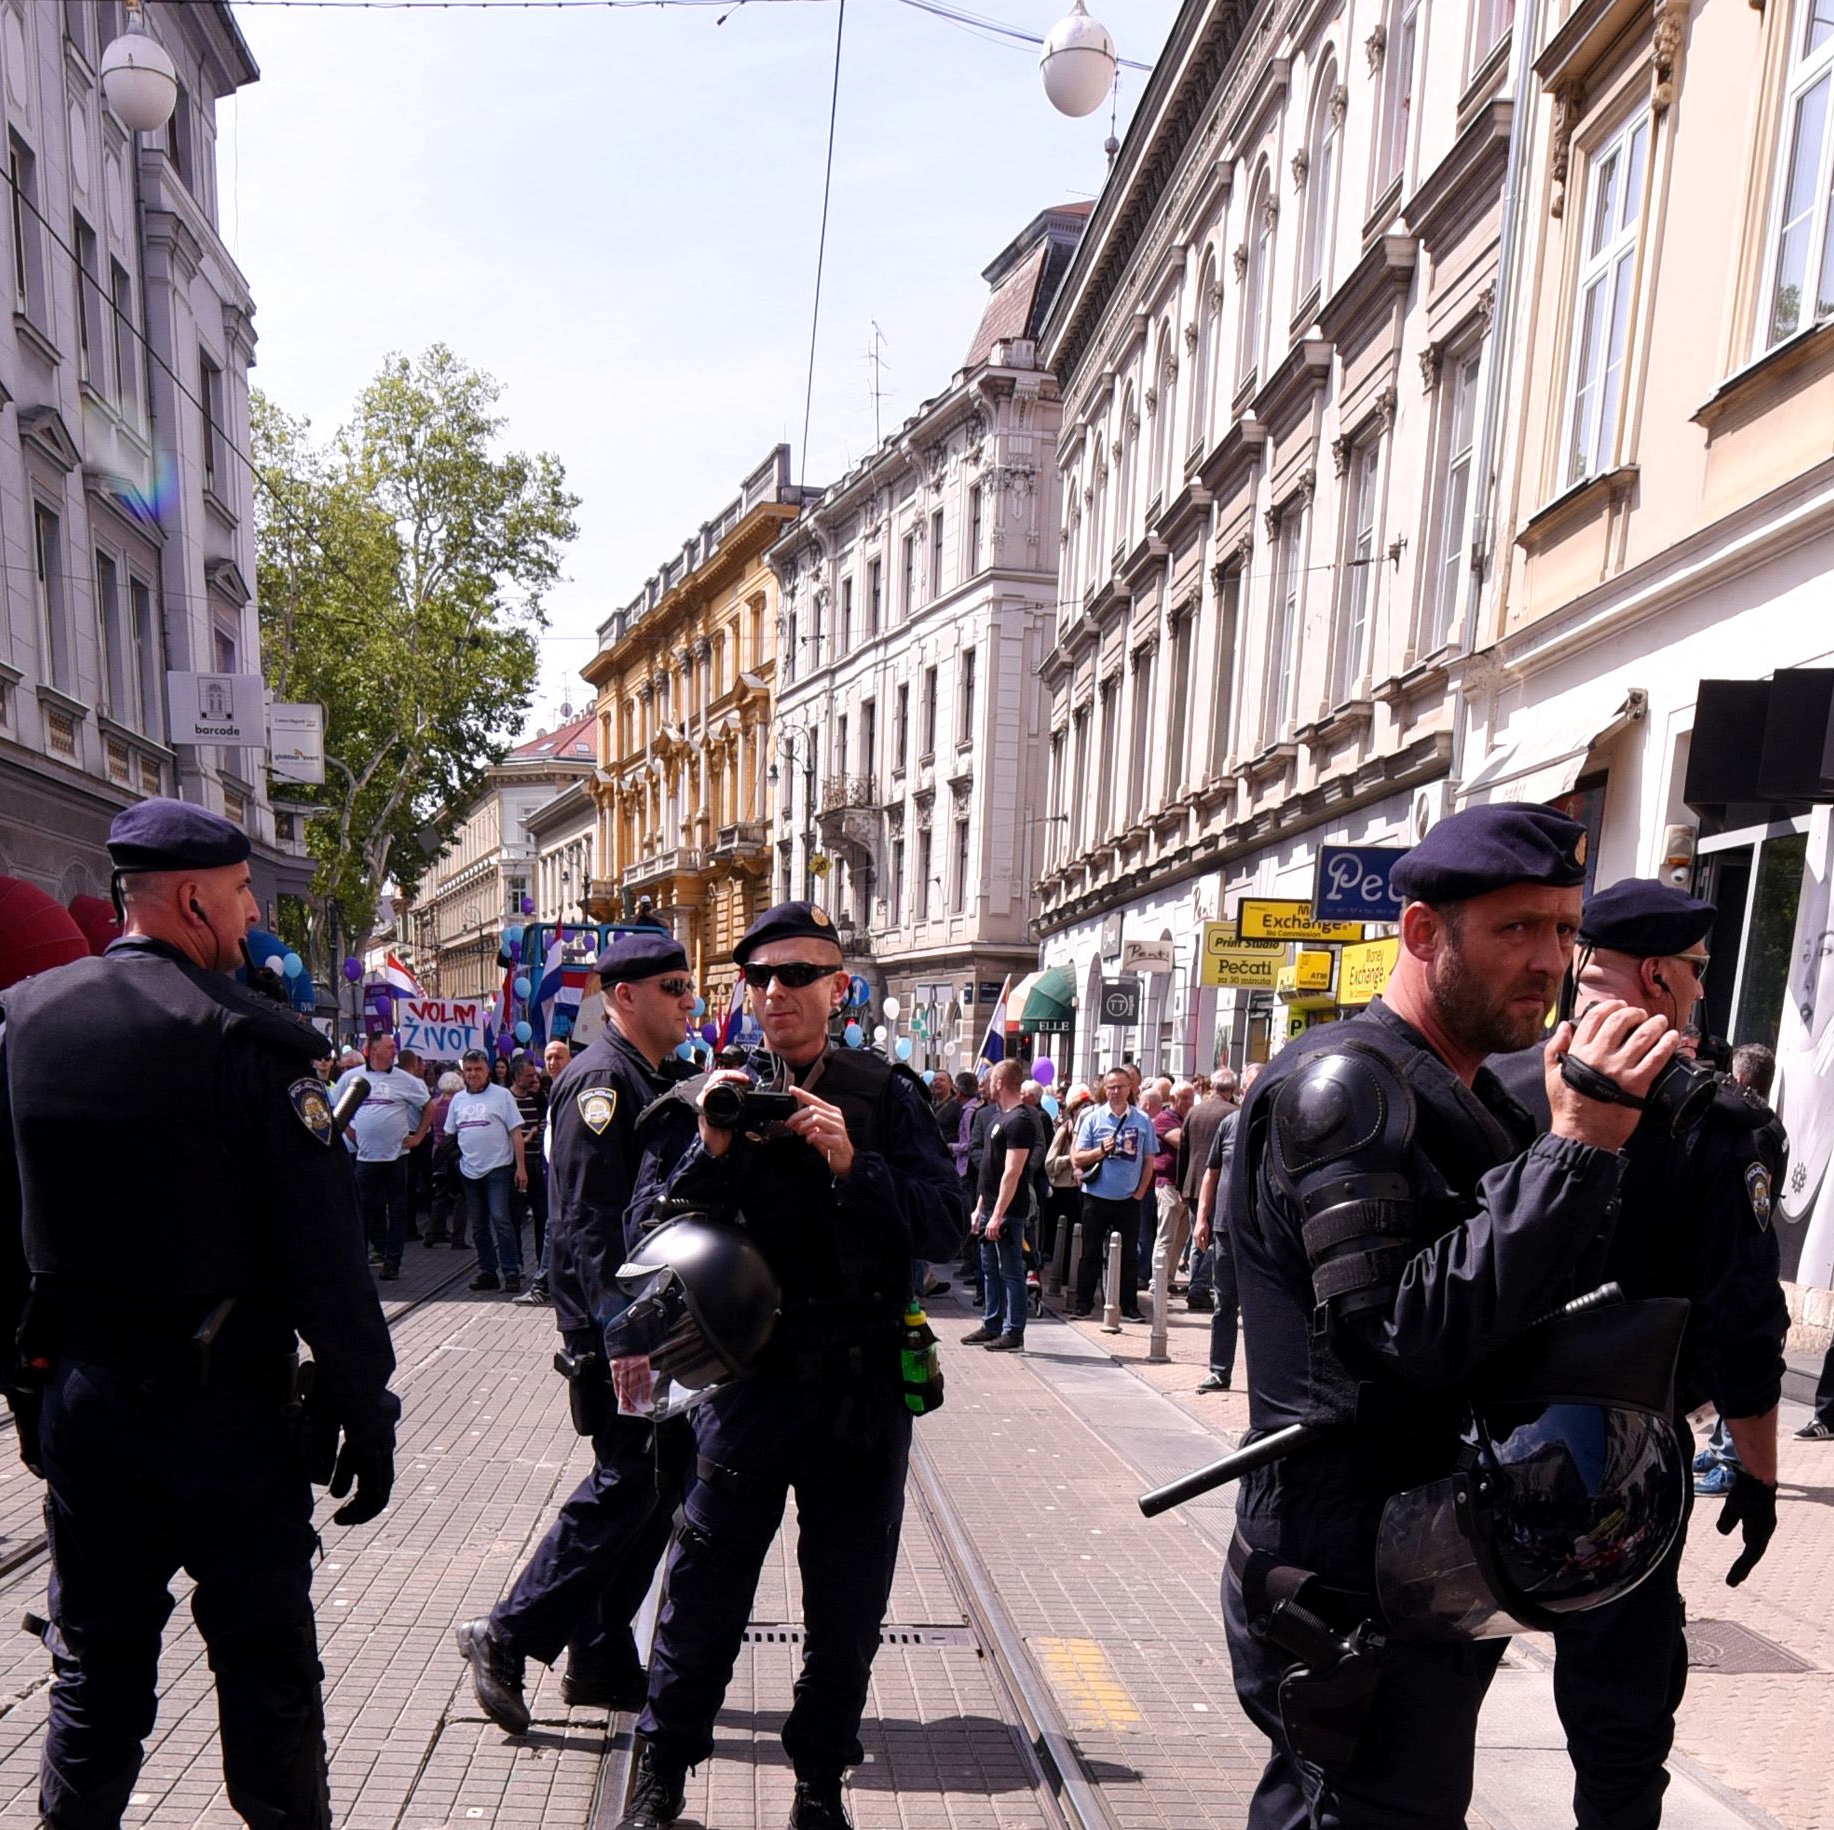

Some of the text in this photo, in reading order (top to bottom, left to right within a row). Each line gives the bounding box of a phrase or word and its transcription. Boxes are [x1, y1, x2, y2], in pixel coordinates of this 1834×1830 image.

[194, 723, 241, 737] barcode
[1218, 959, 1273, 977] Pečati
[1218, 977, 1228, 985] za
[1229, 976, 1240, 986] 30
[1240, 976, 1272, 986] minuta
[407, 1001, 477, 1028] VOLIM
[402, 1016, 479, 1052] ŽIVOT
[1039, 1021, 1070, 1032] ELLE
